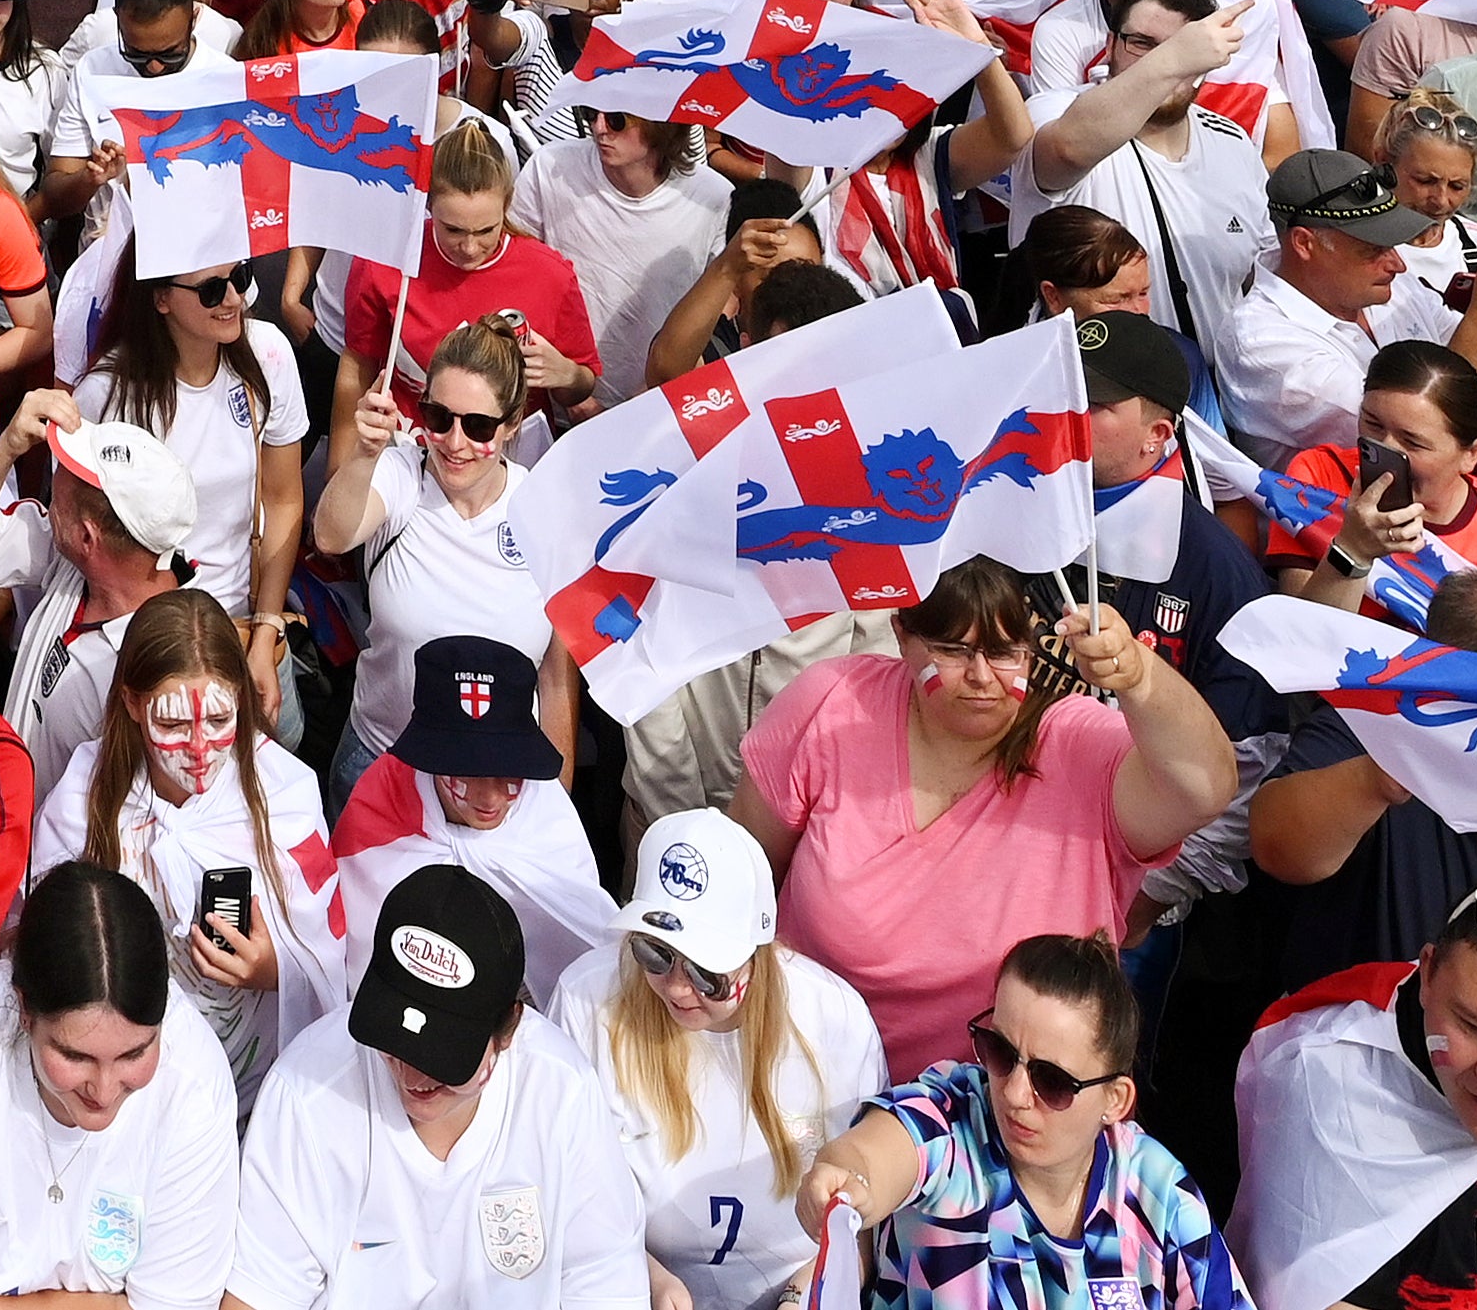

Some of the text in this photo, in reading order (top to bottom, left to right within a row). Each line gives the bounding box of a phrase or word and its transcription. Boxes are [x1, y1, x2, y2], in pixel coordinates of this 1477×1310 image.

[1158, 593, 1188, 611] 1967
[454, 671, 495, 684] ENGLAND
[420, 937, 460, 978] Dutch
[708, 1195, 745, 1266] 7
